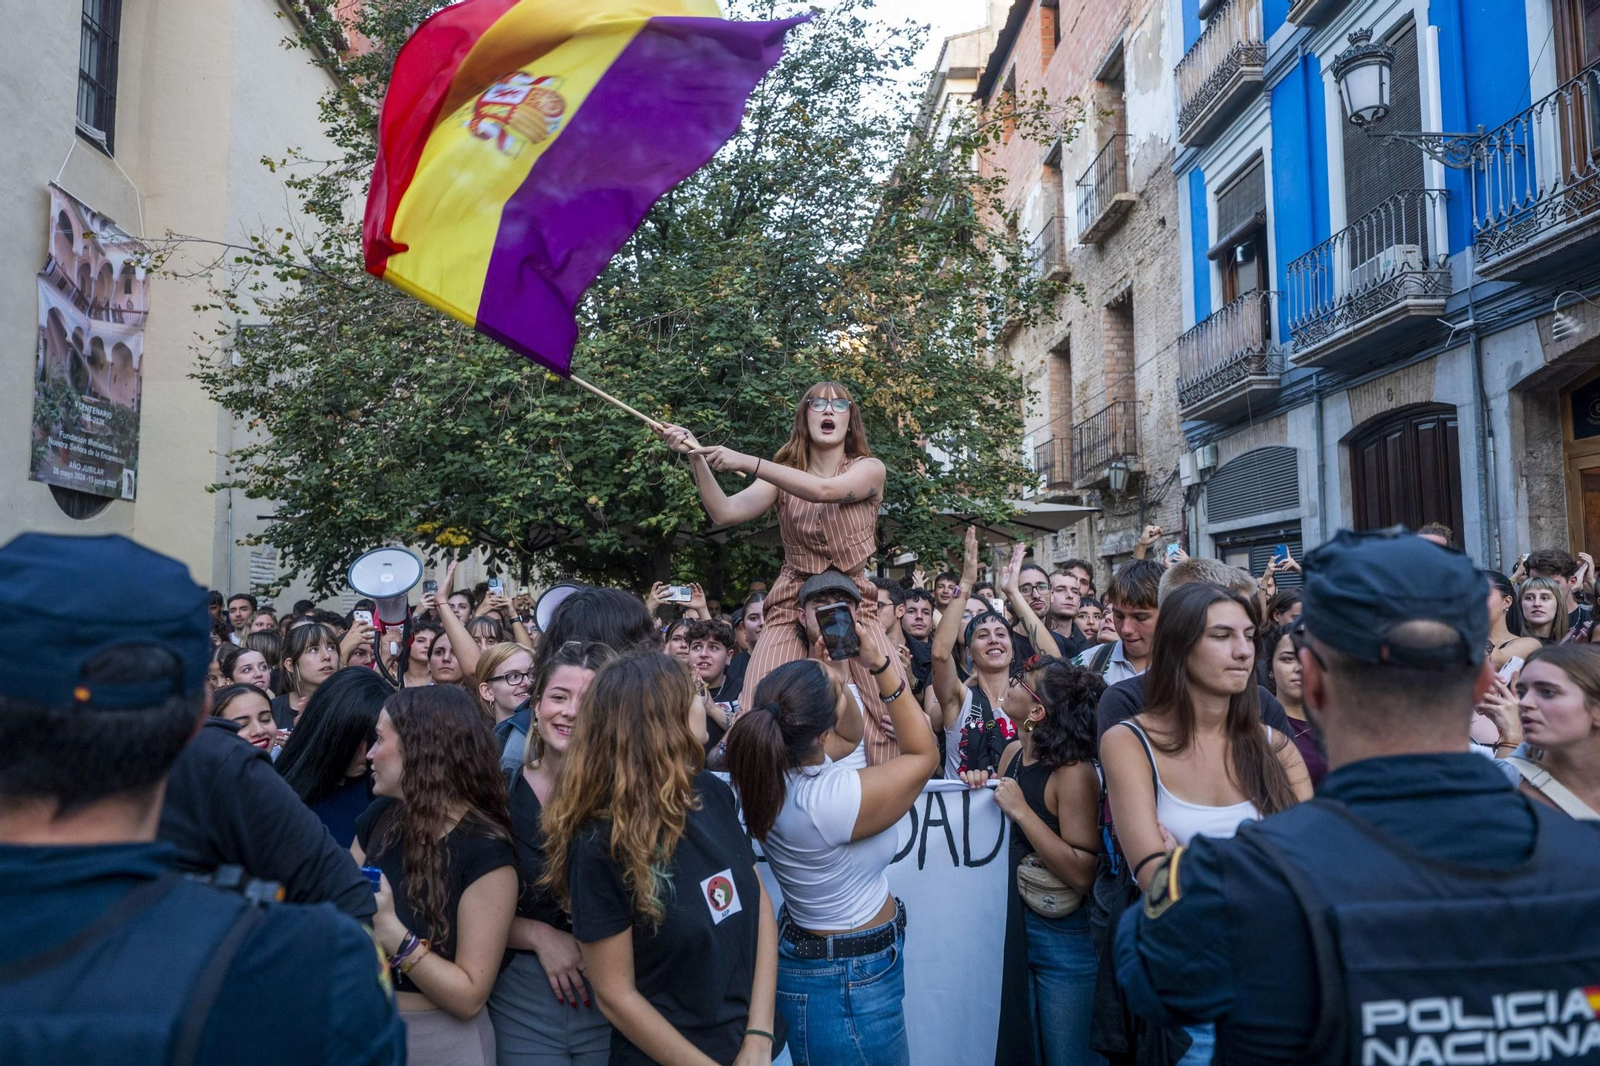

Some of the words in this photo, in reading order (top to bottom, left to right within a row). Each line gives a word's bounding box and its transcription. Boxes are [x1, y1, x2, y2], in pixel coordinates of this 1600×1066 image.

[79, 402, 112, 420] CENTENARIO
[48, 437, 68, 449] Nuestra
[69, 442, 87, 455] Señora
[87, 448, 95, 456] de
[58, 430, 87, 445] Fundación
[52, 466, 60, 475] 26
[60, 469, 73, 479] mayo
[74, 472, 86, 480] 2024
[93, 476, 106, 486] junio
[106, 479, 117, 488] 2025
[68, 461, 81, 470] AÑO
[81, 465, 105, 476] JUBILAR
[1361, 986, 1597, 1037] POLICIA
